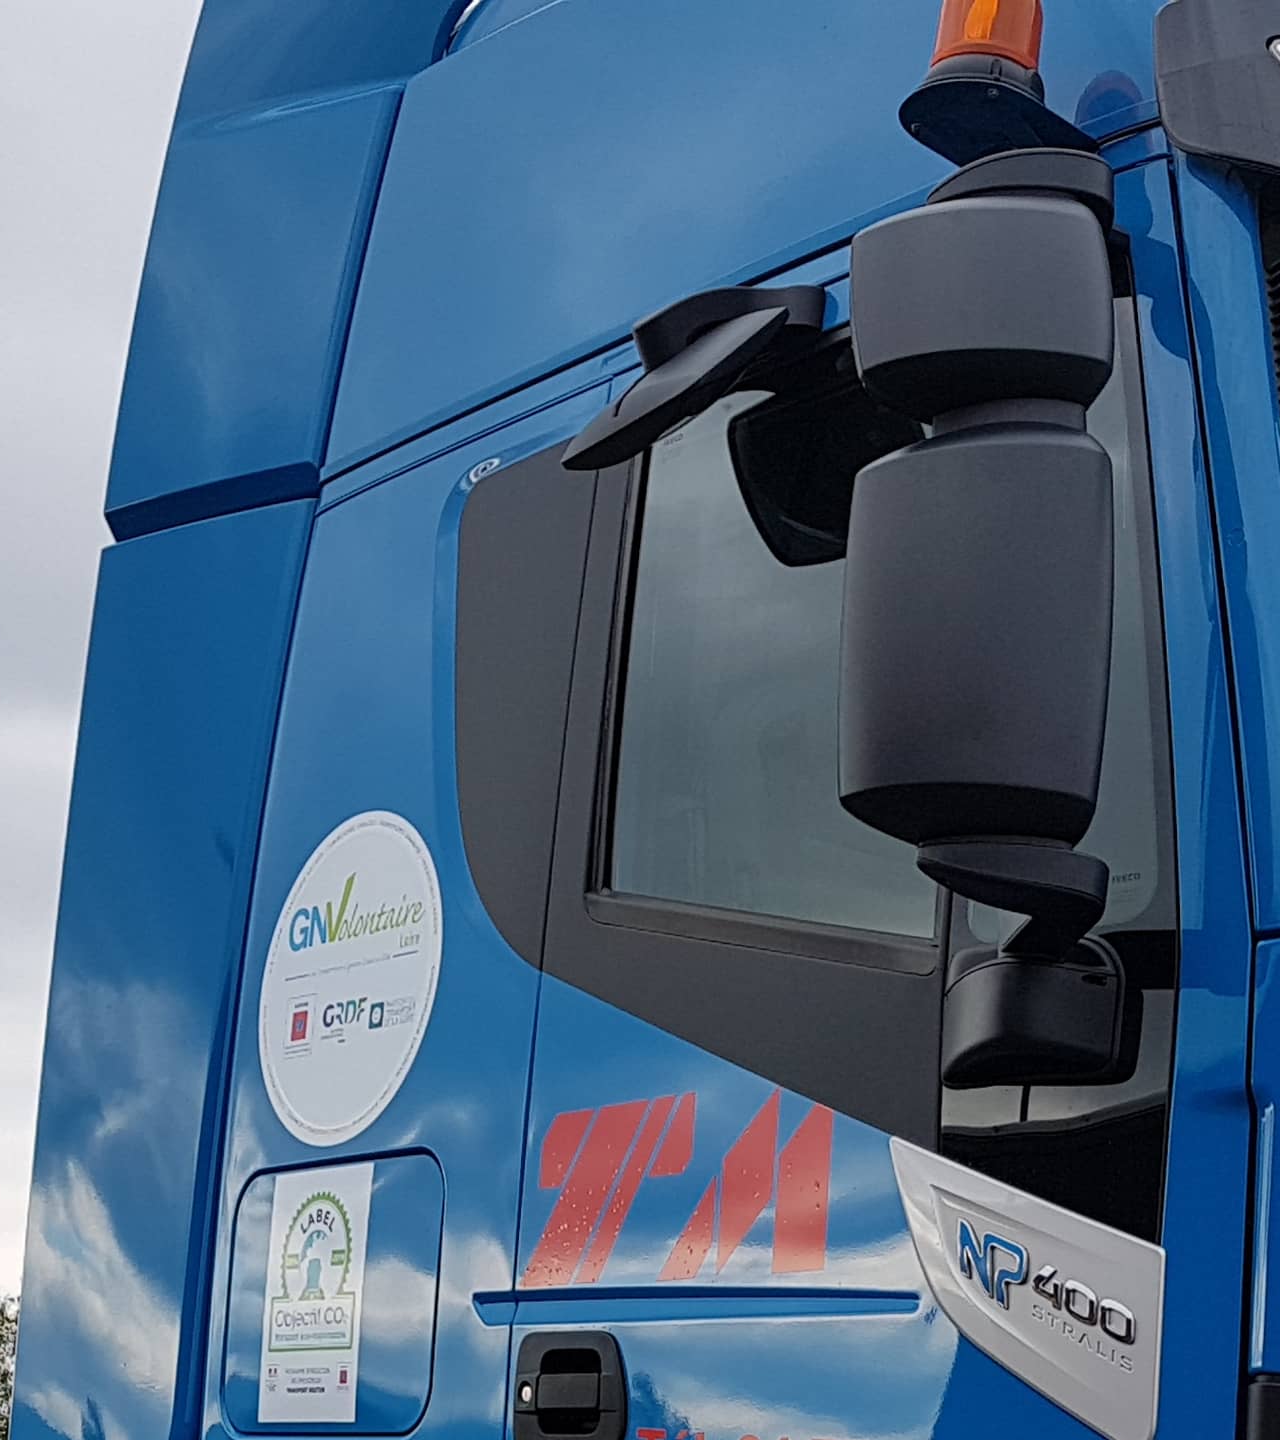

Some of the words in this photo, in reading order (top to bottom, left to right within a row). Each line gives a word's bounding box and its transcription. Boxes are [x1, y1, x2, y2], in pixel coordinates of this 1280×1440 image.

[322, 996, 368, 1029] GRDF
[300, 1208, 337, 1234] LABEL
[957, 1217, 1030, 1311] NP
[1032, 1264, 1136, 1346] 400
[1032, 1303, 1135, 1374] STRALIS
